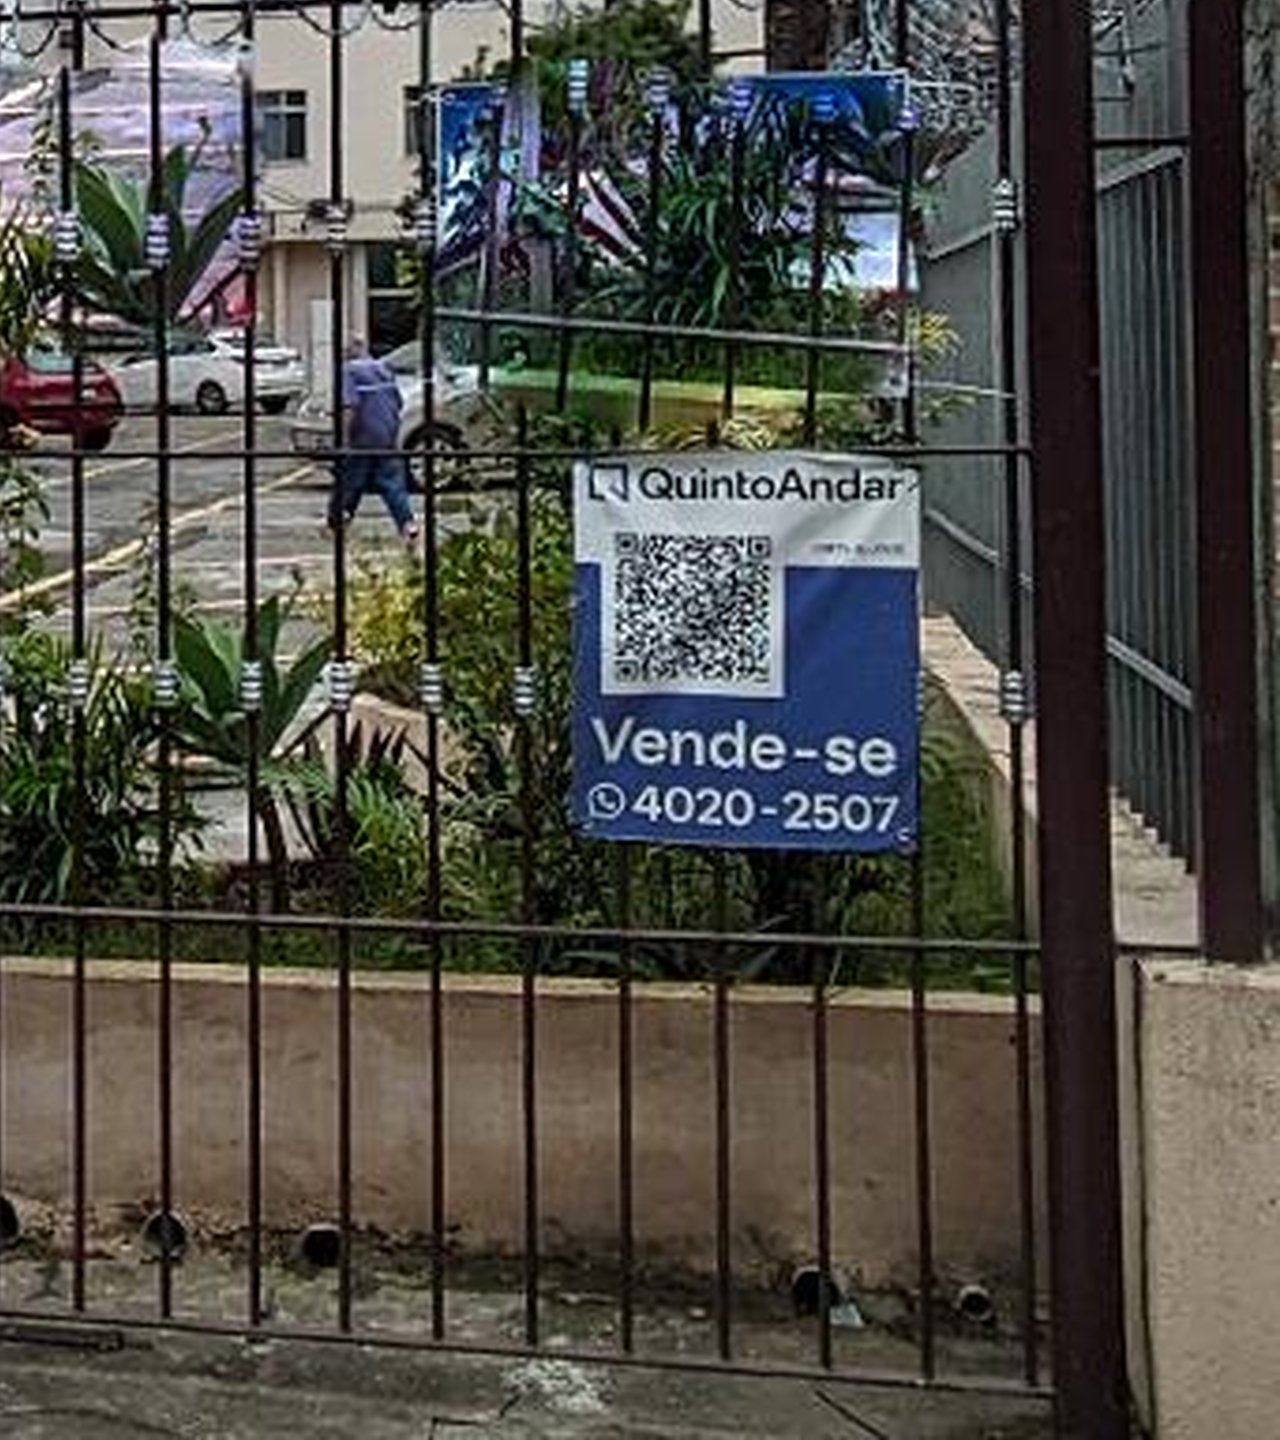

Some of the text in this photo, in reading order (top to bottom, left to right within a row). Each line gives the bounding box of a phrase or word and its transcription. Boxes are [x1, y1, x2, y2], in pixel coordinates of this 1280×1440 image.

[639, 467, 905, 502] QuintoAndar
[591, 717, 898, 777] Vende-se
[632, 785, 900, 833] 4020-2507
